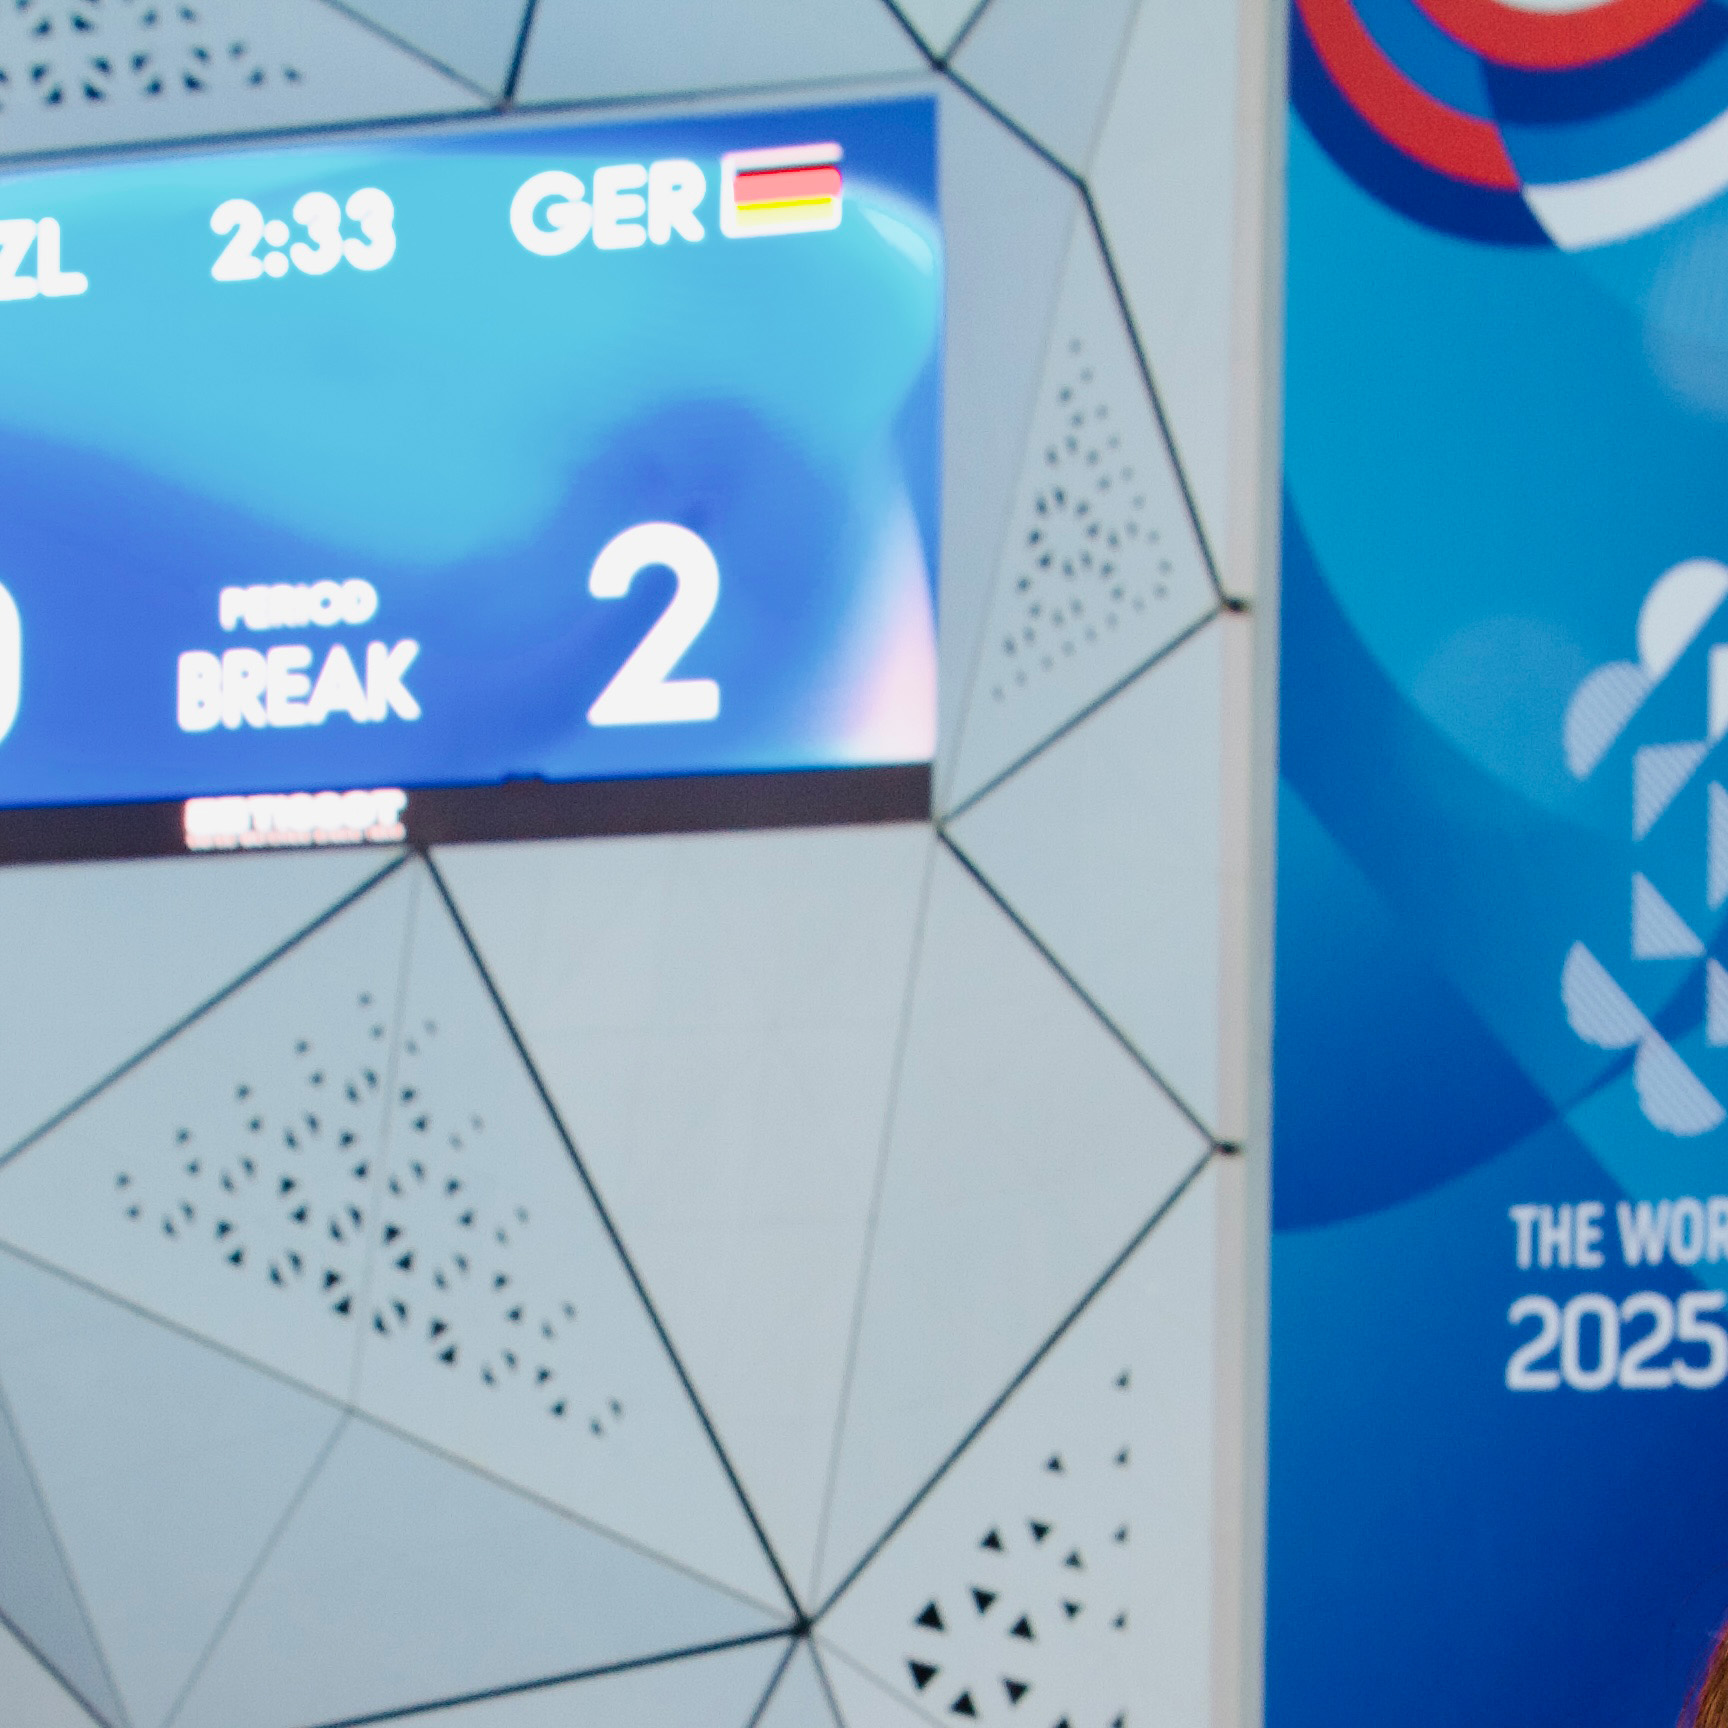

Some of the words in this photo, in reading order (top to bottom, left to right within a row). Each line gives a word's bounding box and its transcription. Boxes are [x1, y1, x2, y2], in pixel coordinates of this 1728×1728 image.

[208, 188, 396, 281] 2:33
[510, 160, 706, 255] GER
[219, 579, 378, 630] PERIOD
[587, 522, 720, 726] 2
[178, 638, 421, 732] BREAK
[1509, 1202, 1605, 1270] THE
